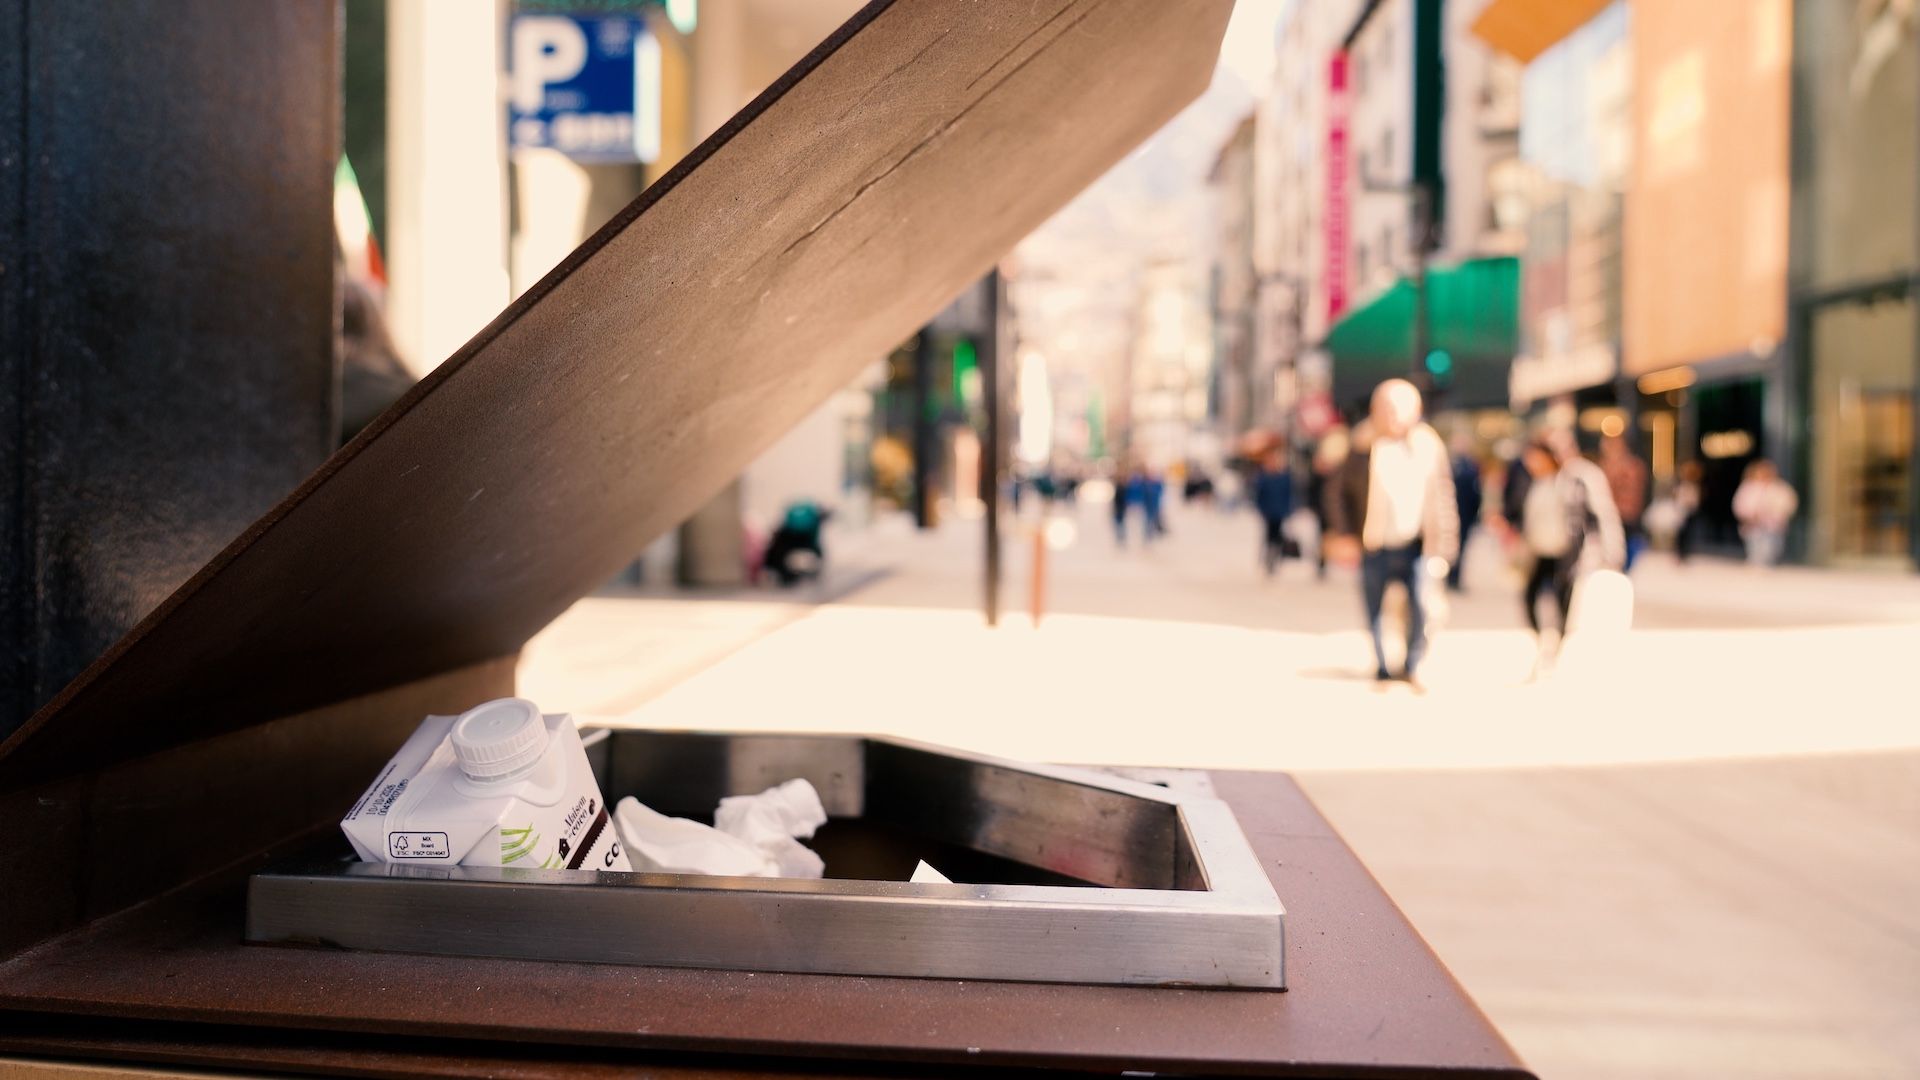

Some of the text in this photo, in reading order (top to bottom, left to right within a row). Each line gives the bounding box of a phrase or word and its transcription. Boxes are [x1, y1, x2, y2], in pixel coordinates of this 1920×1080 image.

[512, 15, 588, 113] P
[564, 795, 587, 828] Maison
[571, 809, 588, 836] coco
[605, 841, 621, 867] CO
